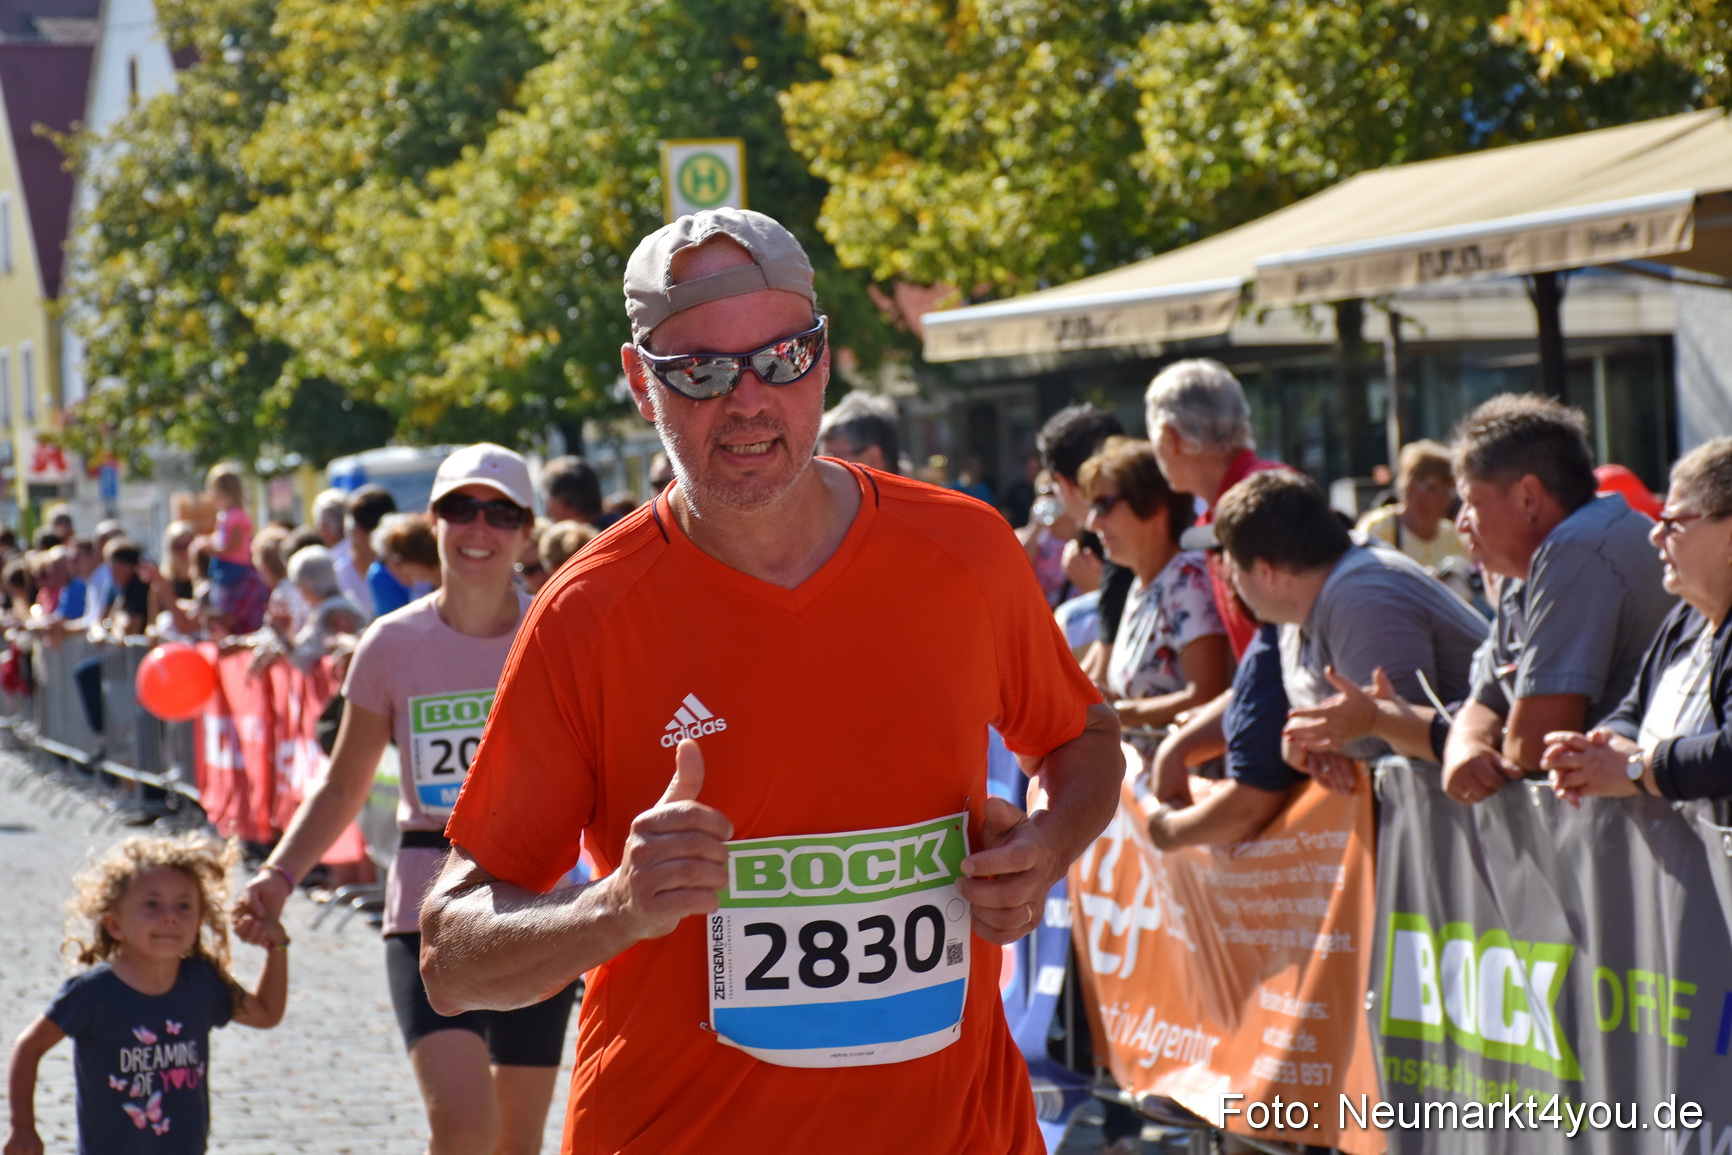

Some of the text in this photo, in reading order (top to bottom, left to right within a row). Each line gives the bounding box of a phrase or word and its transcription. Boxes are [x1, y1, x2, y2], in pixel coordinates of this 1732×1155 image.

[660, 718, 727, 748] adidas
[440, 786, 460, 804] M
[729, 829, 951, 898] BOCK
[743, 904, 946, 991] 2830
[1385, 918, 1576, 1073] BOCK
[132, 1072, 155, 1098] OF
